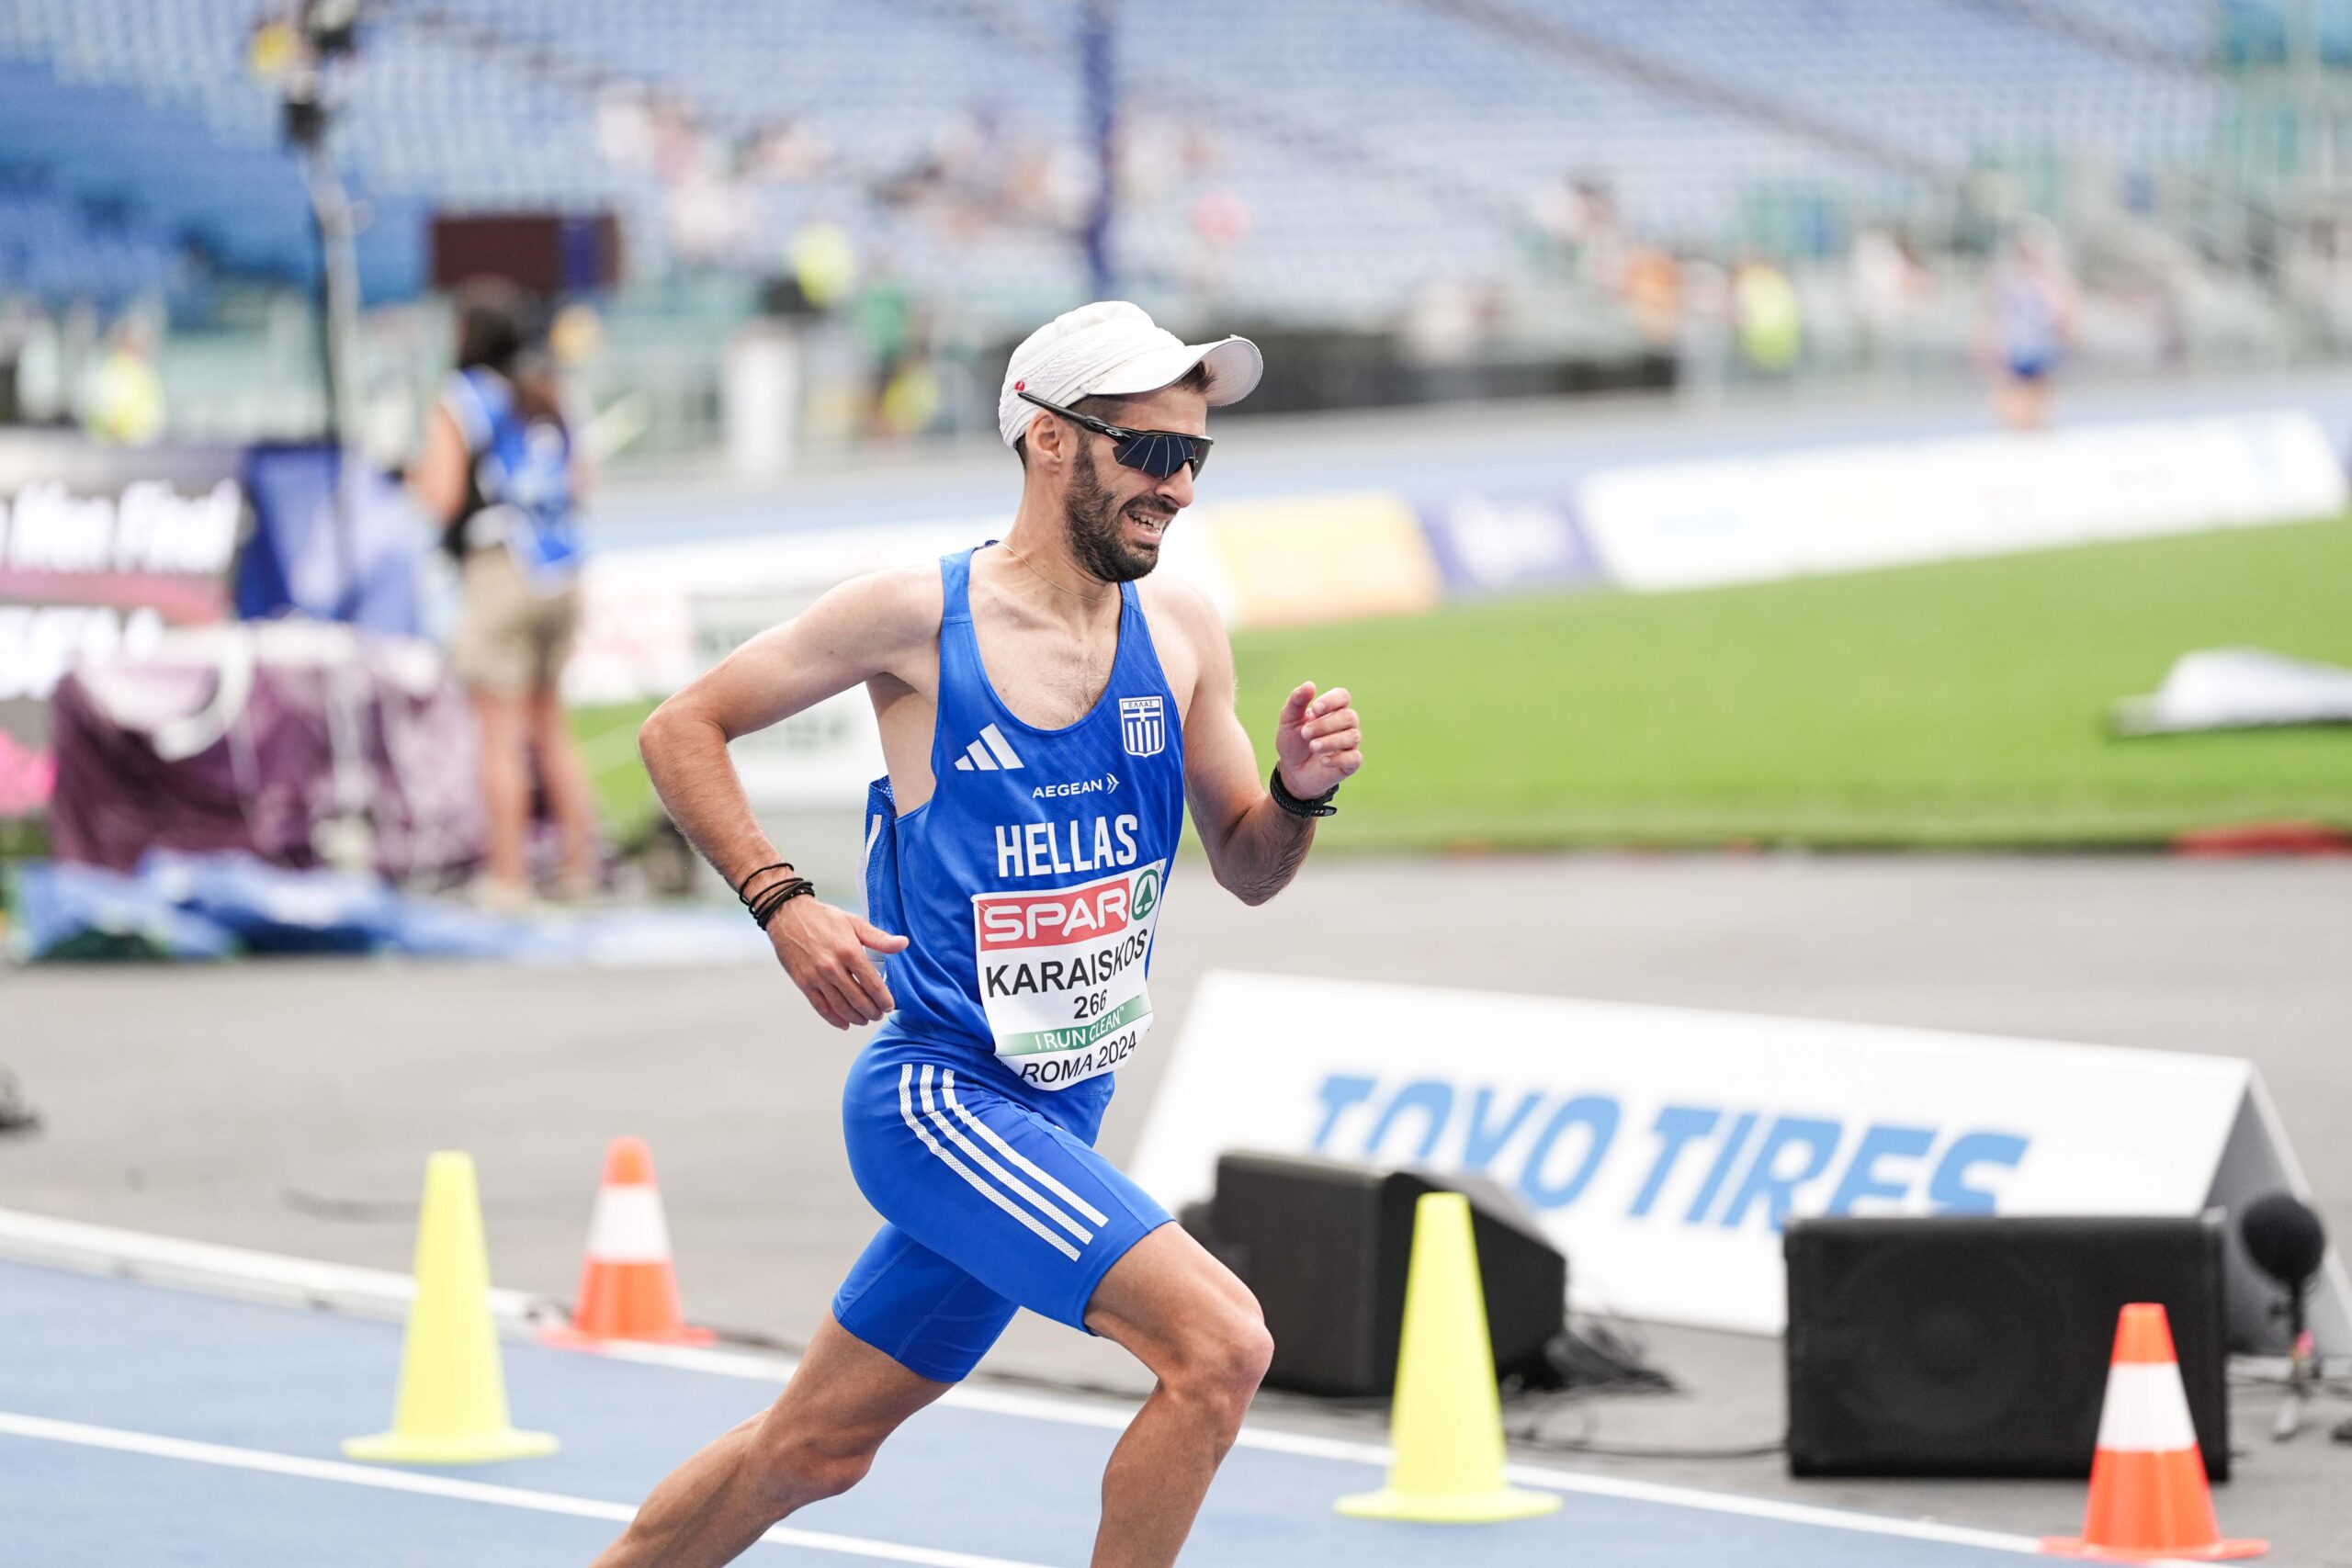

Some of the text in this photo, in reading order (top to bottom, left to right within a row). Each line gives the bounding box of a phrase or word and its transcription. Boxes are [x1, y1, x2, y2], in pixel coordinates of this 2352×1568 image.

[1032, 779, 1103, 799] AEGEAN
[995, 814, 1138, 878] HELLAS
[983, 887, 1127, 942] SPAR
[986, 928, 1148, 998] KARAISKOS
[1073, 989, 1108, 1020] 266
[1021, 1031, 1137, 1084] ROMA 2024
[1035, 1034, 1042, 1051] I
[1044, 1027, 1087, 1051] RUN
[1627, 1106, 2030, 1234] TIRES
